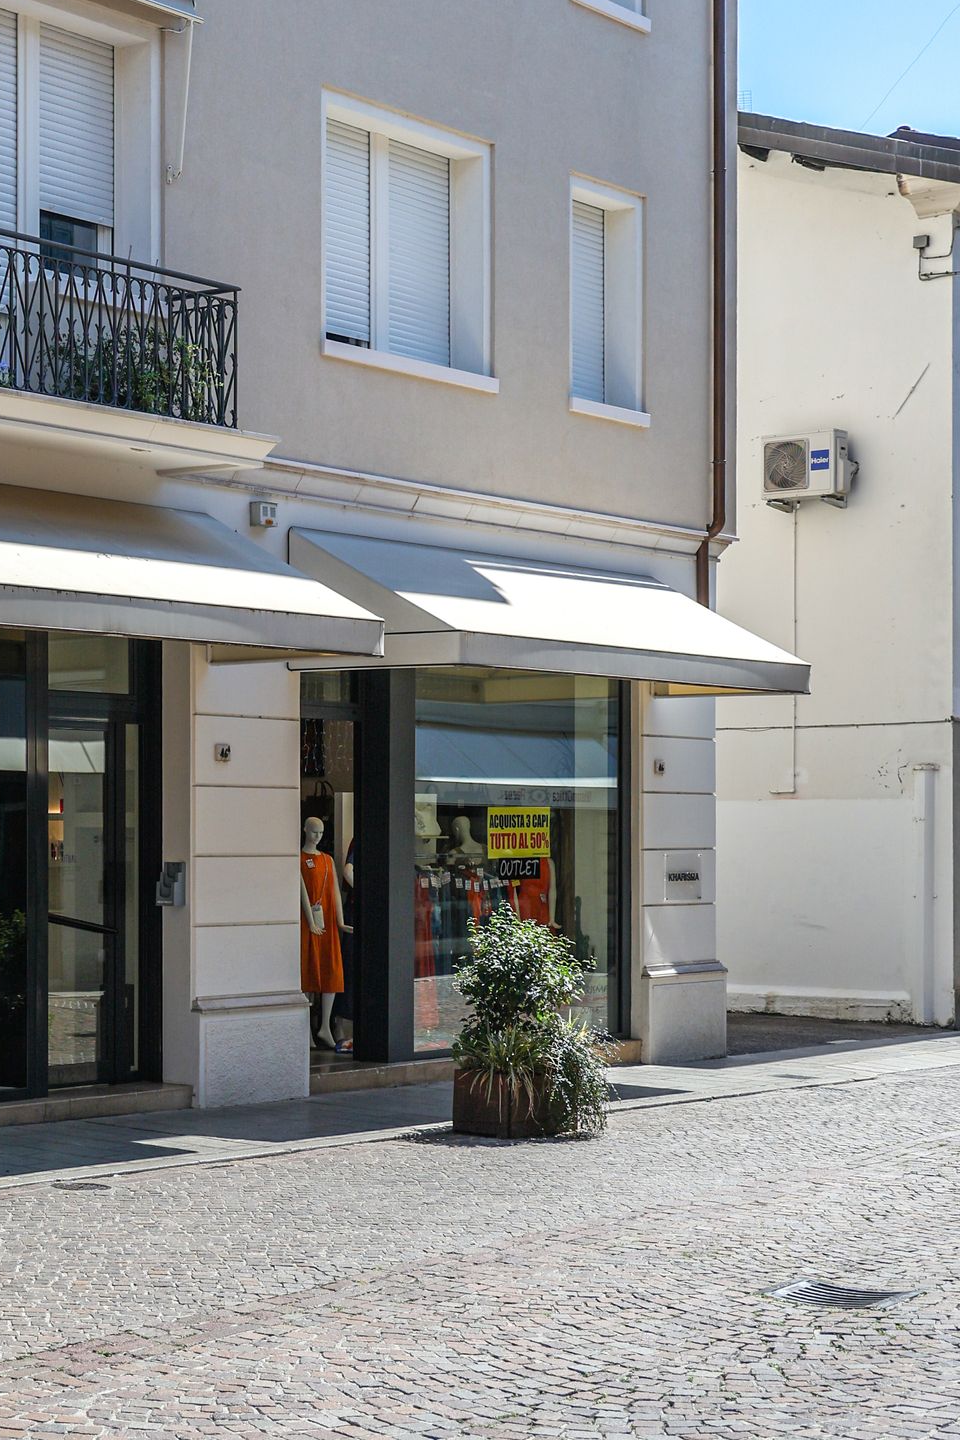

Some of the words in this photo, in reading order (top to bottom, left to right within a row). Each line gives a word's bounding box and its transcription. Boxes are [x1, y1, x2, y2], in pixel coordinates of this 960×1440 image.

[489, 814, 525, 829] ACQUISTA
[526, 814, 531, 828] 3
[532, 814, 549, 828] CAPI
[490, 832, 517, 850] TUTTO
[519, 832, 528, 849] AL
[530, 832, 549, 849] 50%
[500, 859, 540, 876] OUTLET
